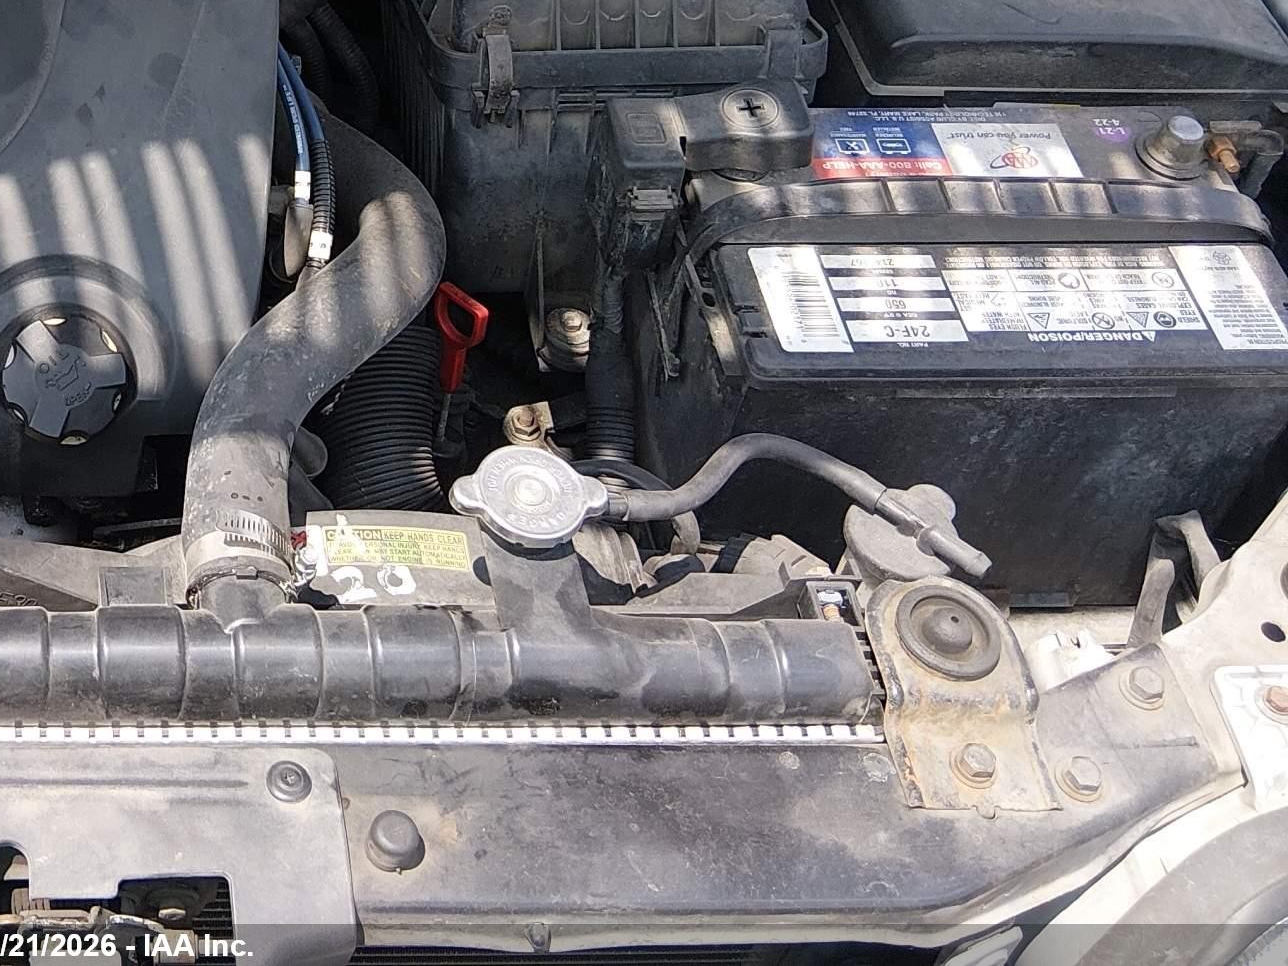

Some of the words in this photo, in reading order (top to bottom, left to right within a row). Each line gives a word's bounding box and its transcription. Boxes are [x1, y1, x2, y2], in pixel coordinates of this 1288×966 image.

[1092, 118, 1120, 126] 4-22
[994, 131, 1017, 140] you
[1019, 132, 1051, 140] Power
[914, 161, 943, 170] Call:
[883, 325, 931, 339] 24F-C
[1027, 331, 1145, 342] DANGER/POISON
[325, 529, 381, 541] CTION
[383, 530, 404, 541] KEEP
[407, 530, 434, 542] HANDS
[437, 533, 464, 545] CLEAR
[364, 541, 397, 549] ERSONAL
[388, 548, 411, 556] START
[398, 556, 423, 564] ENGINE
